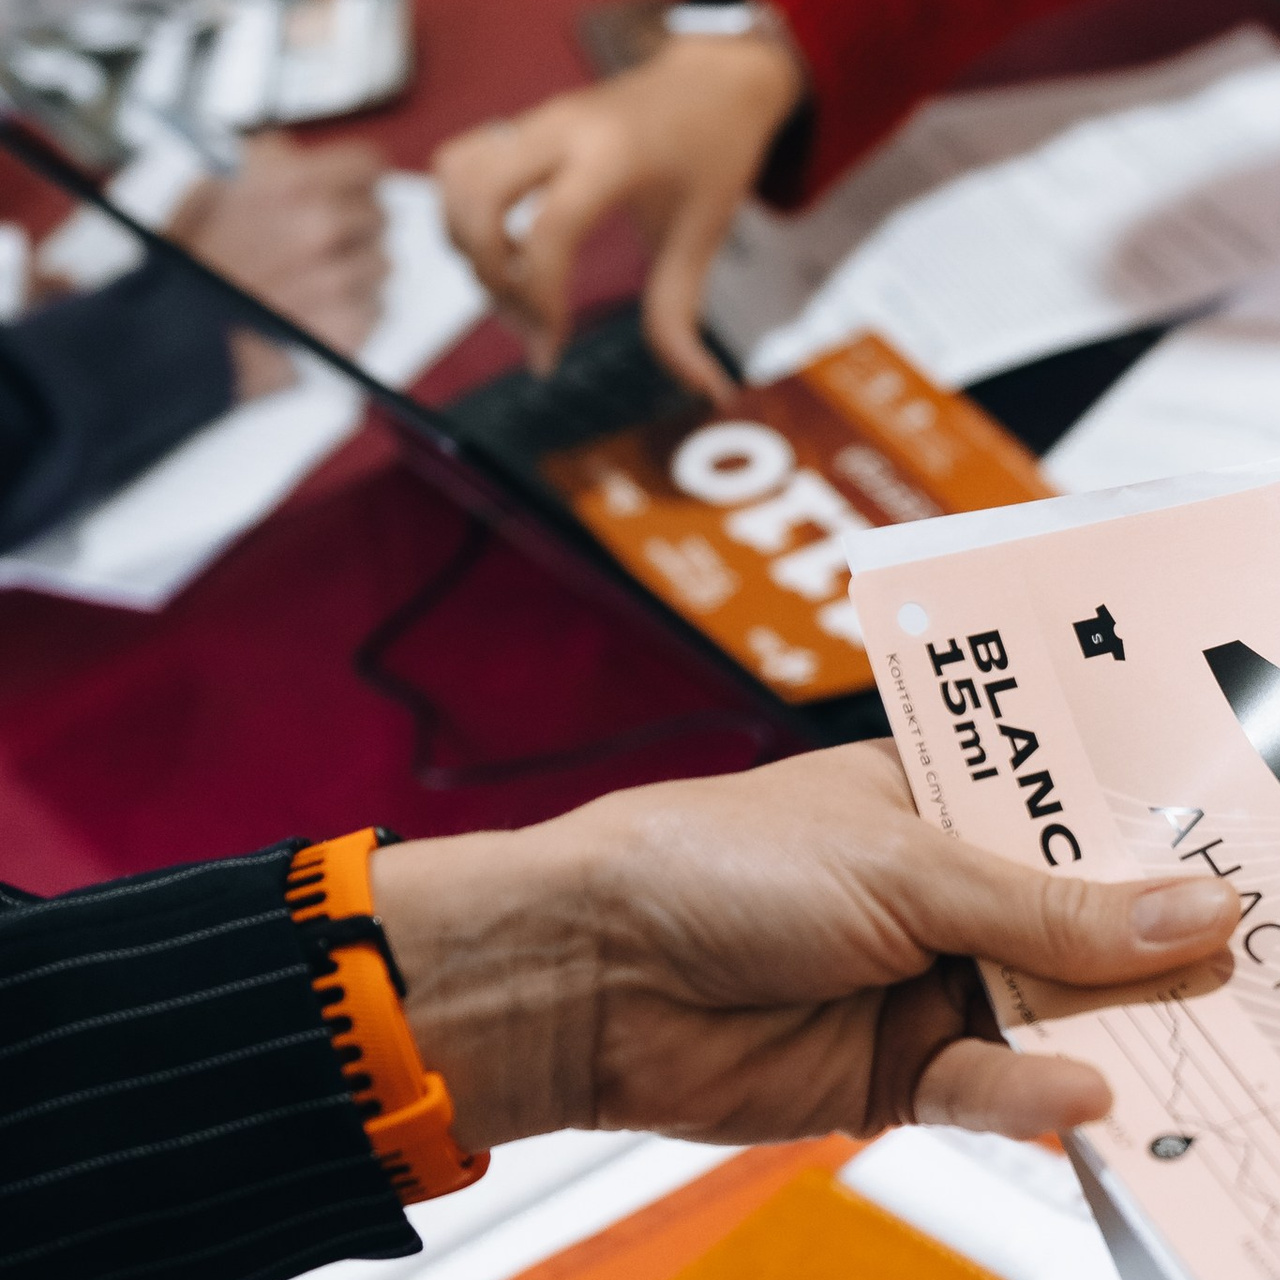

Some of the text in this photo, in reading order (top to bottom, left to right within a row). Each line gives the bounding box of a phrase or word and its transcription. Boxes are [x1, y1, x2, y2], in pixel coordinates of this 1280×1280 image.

[1091, 632, 1103, 645] S
[886, 653, 923, 737] Контакт
[915, 742, 932, 767] на
[925, 638, 999, 782] 15ml
[967, 629, 1082, 867] BLANC
